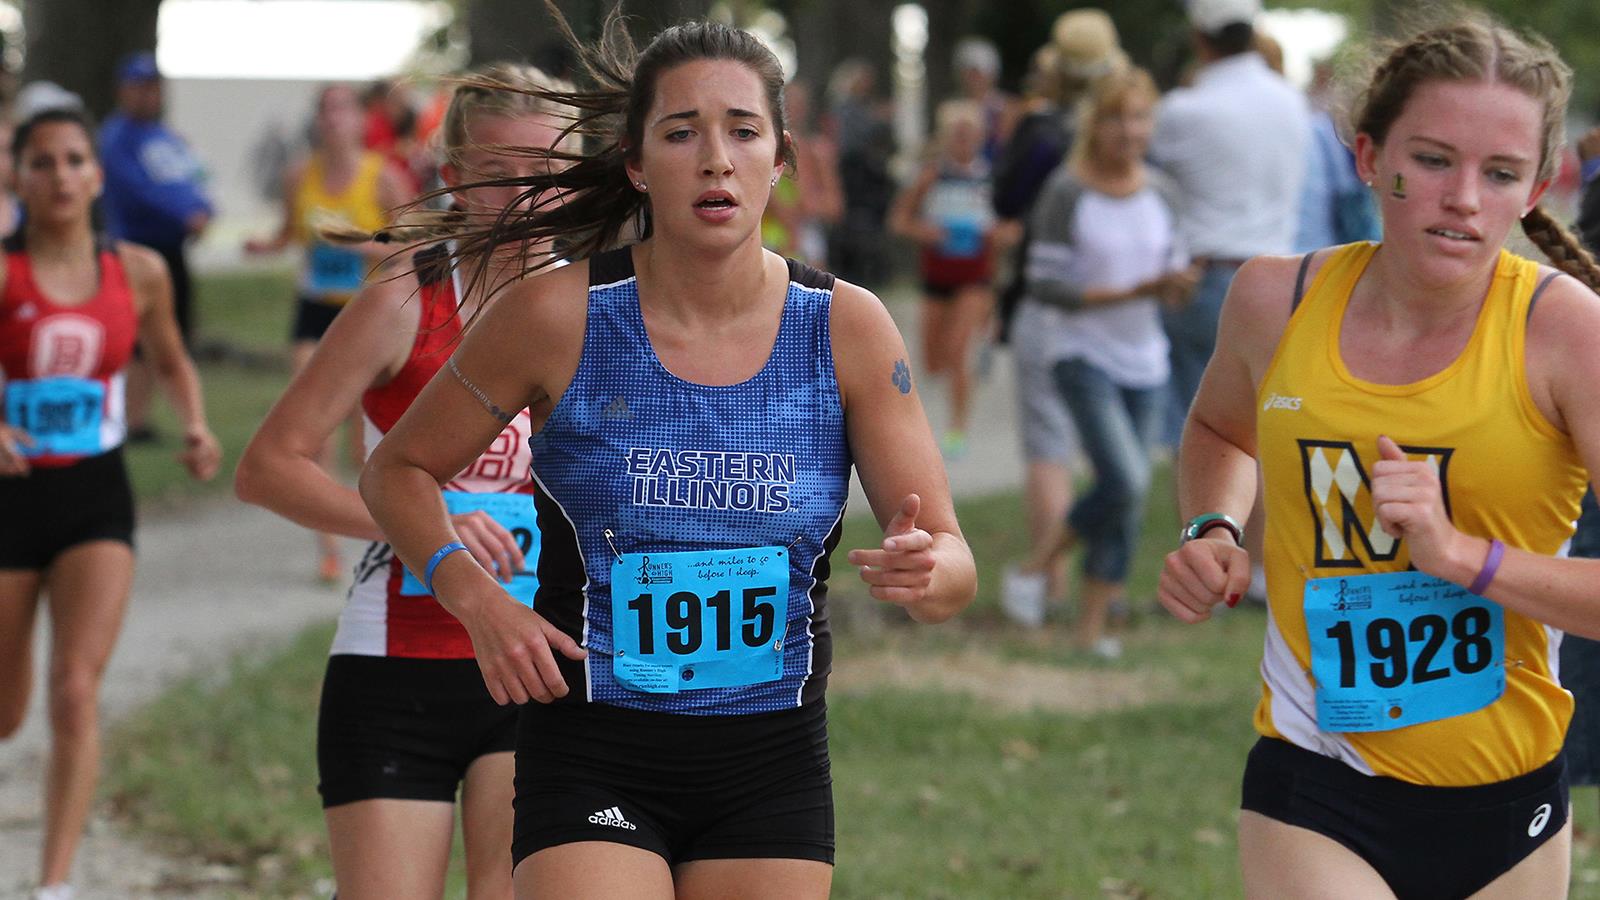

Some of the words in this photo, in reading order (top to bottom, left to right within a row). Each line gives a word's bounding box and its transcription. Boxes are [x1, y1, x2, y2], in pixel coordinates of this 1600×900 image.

[625, 448, 796, 484] EASTERN
[633, 476, 791, 514] ILLINOIS
[1297, 439, 1455, 569] N
[698, 568, 725, 581] before
[718, 556, 744, 566] miles
[746, 556, 757, 565] to
[759, 556, 769, 566] go
[627, 586, 777, 656] 1915
[1326, 606, 1492, 689] 1928
[588, 815, 637, 830] adidas
